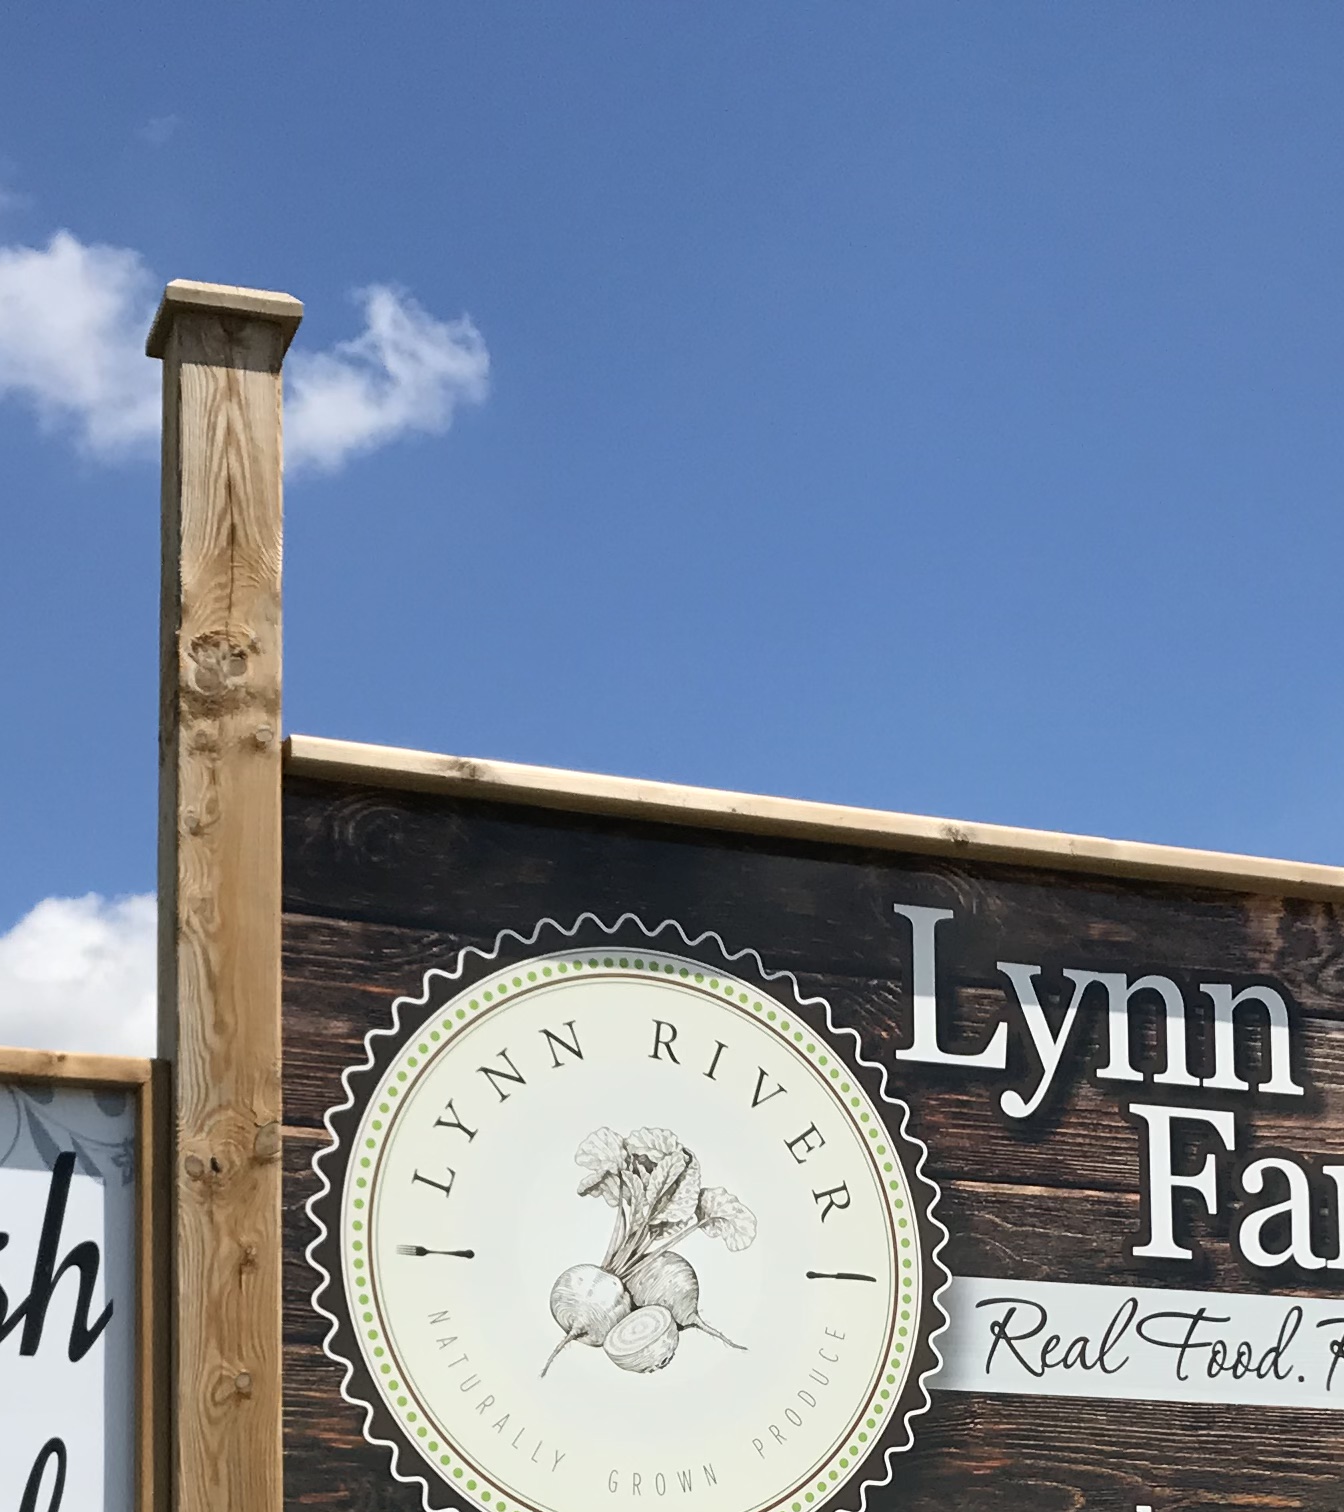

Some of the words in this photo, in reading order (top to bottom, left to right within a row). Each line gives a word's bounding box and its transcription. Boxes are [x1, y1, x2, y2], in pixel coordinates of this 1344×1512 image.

[892, 904, 1305, 1120] Lynn
[412, 1021, 585, 1197] LYNN
[648, 1018, 851, 1223] RIVER
[427, 1309, 566, 1473] NATURALLY
[607, 1463, 719, 1497] GROWN
[752, 1325, 847, 1460] PRODUCE
[976, 1297, 1138, 1378] Real
[1136, 1306, 1305, 1383] Food.
